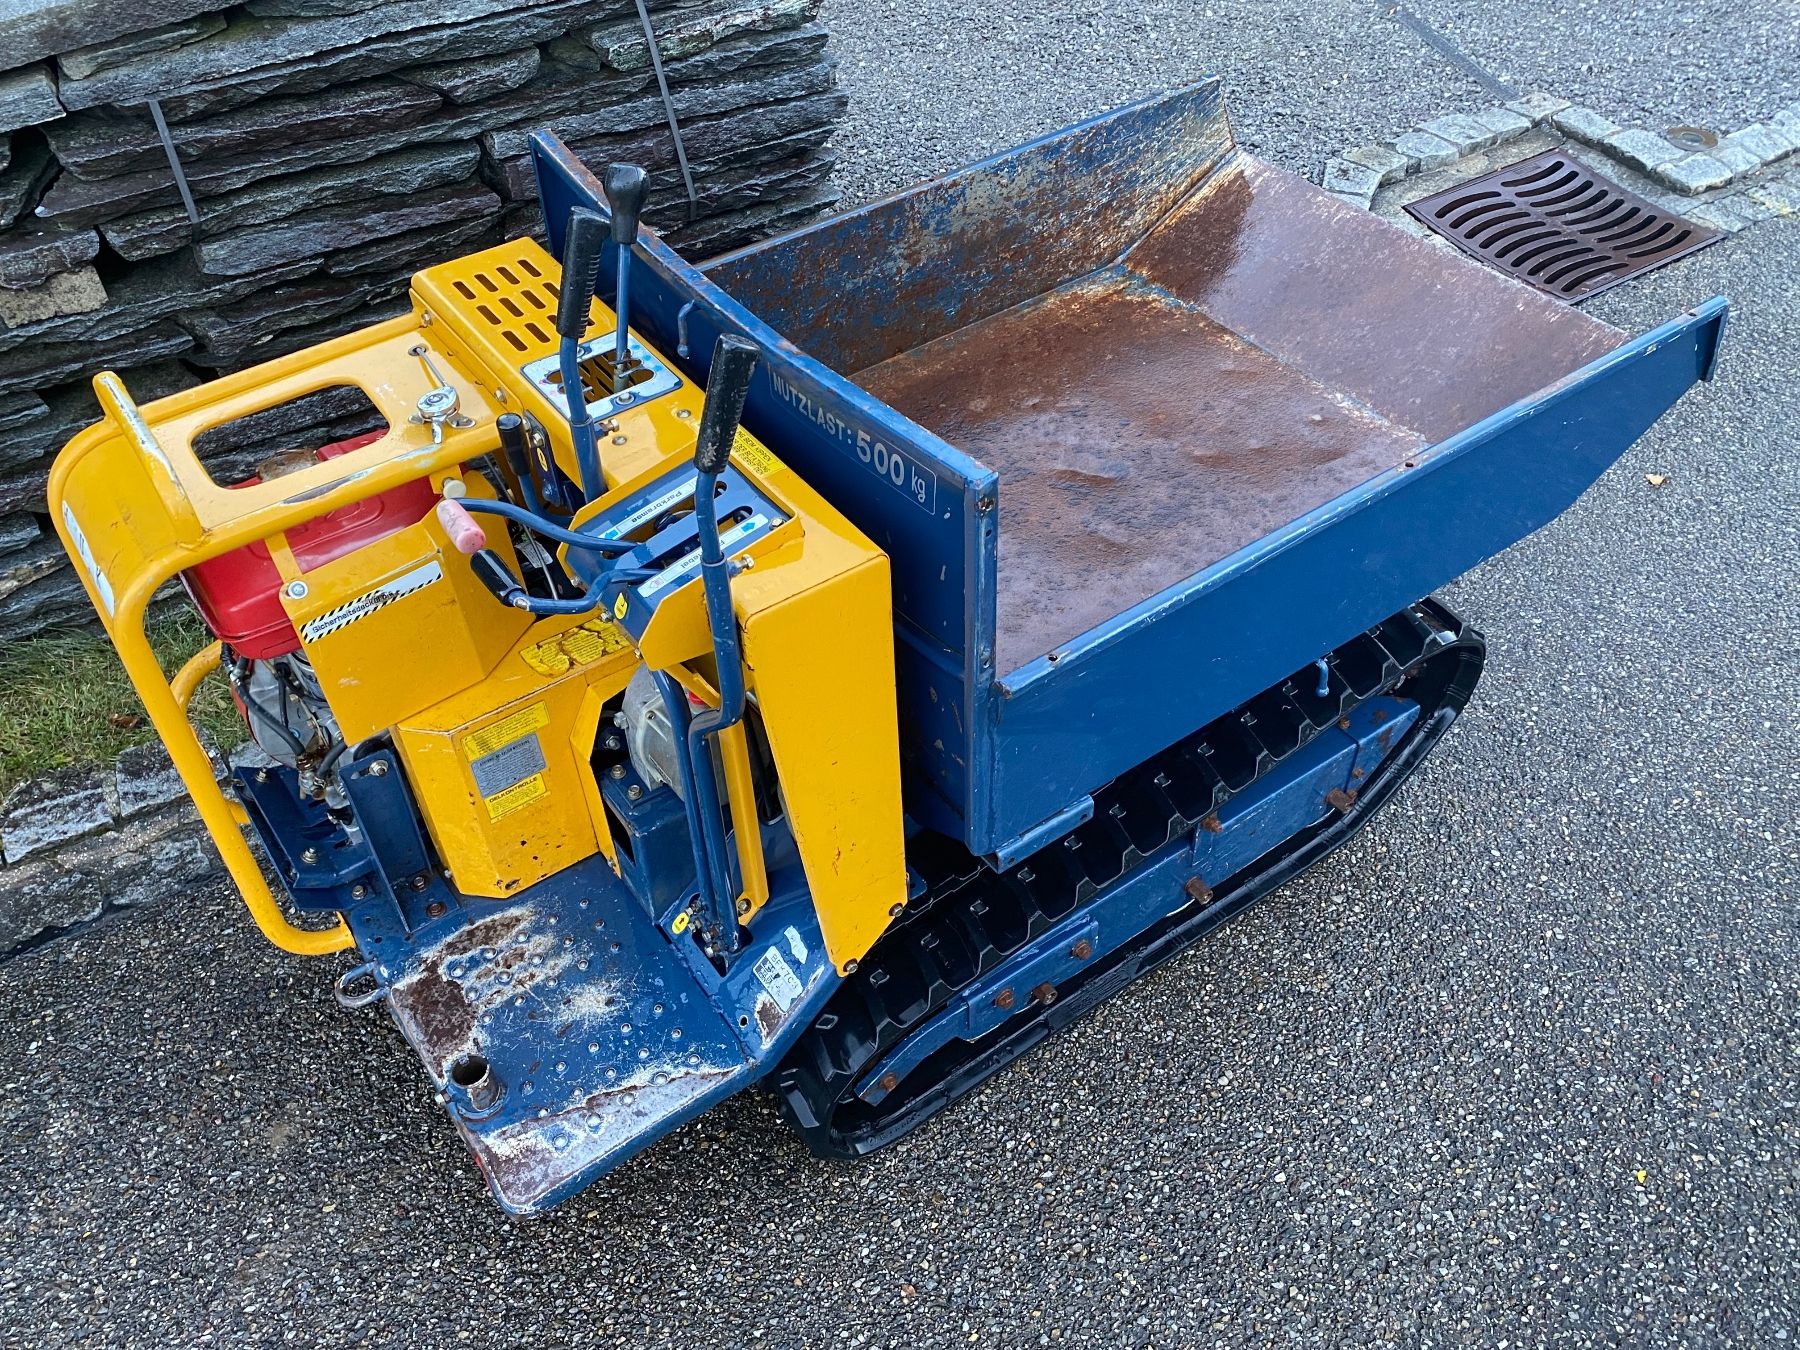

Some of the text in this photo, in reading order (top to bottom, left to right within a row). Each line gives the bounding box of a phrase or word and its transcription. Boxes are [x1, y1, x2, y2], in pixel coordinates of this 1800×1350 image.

[772, 371, 926, 503] NUTZLAST: 500 kg
